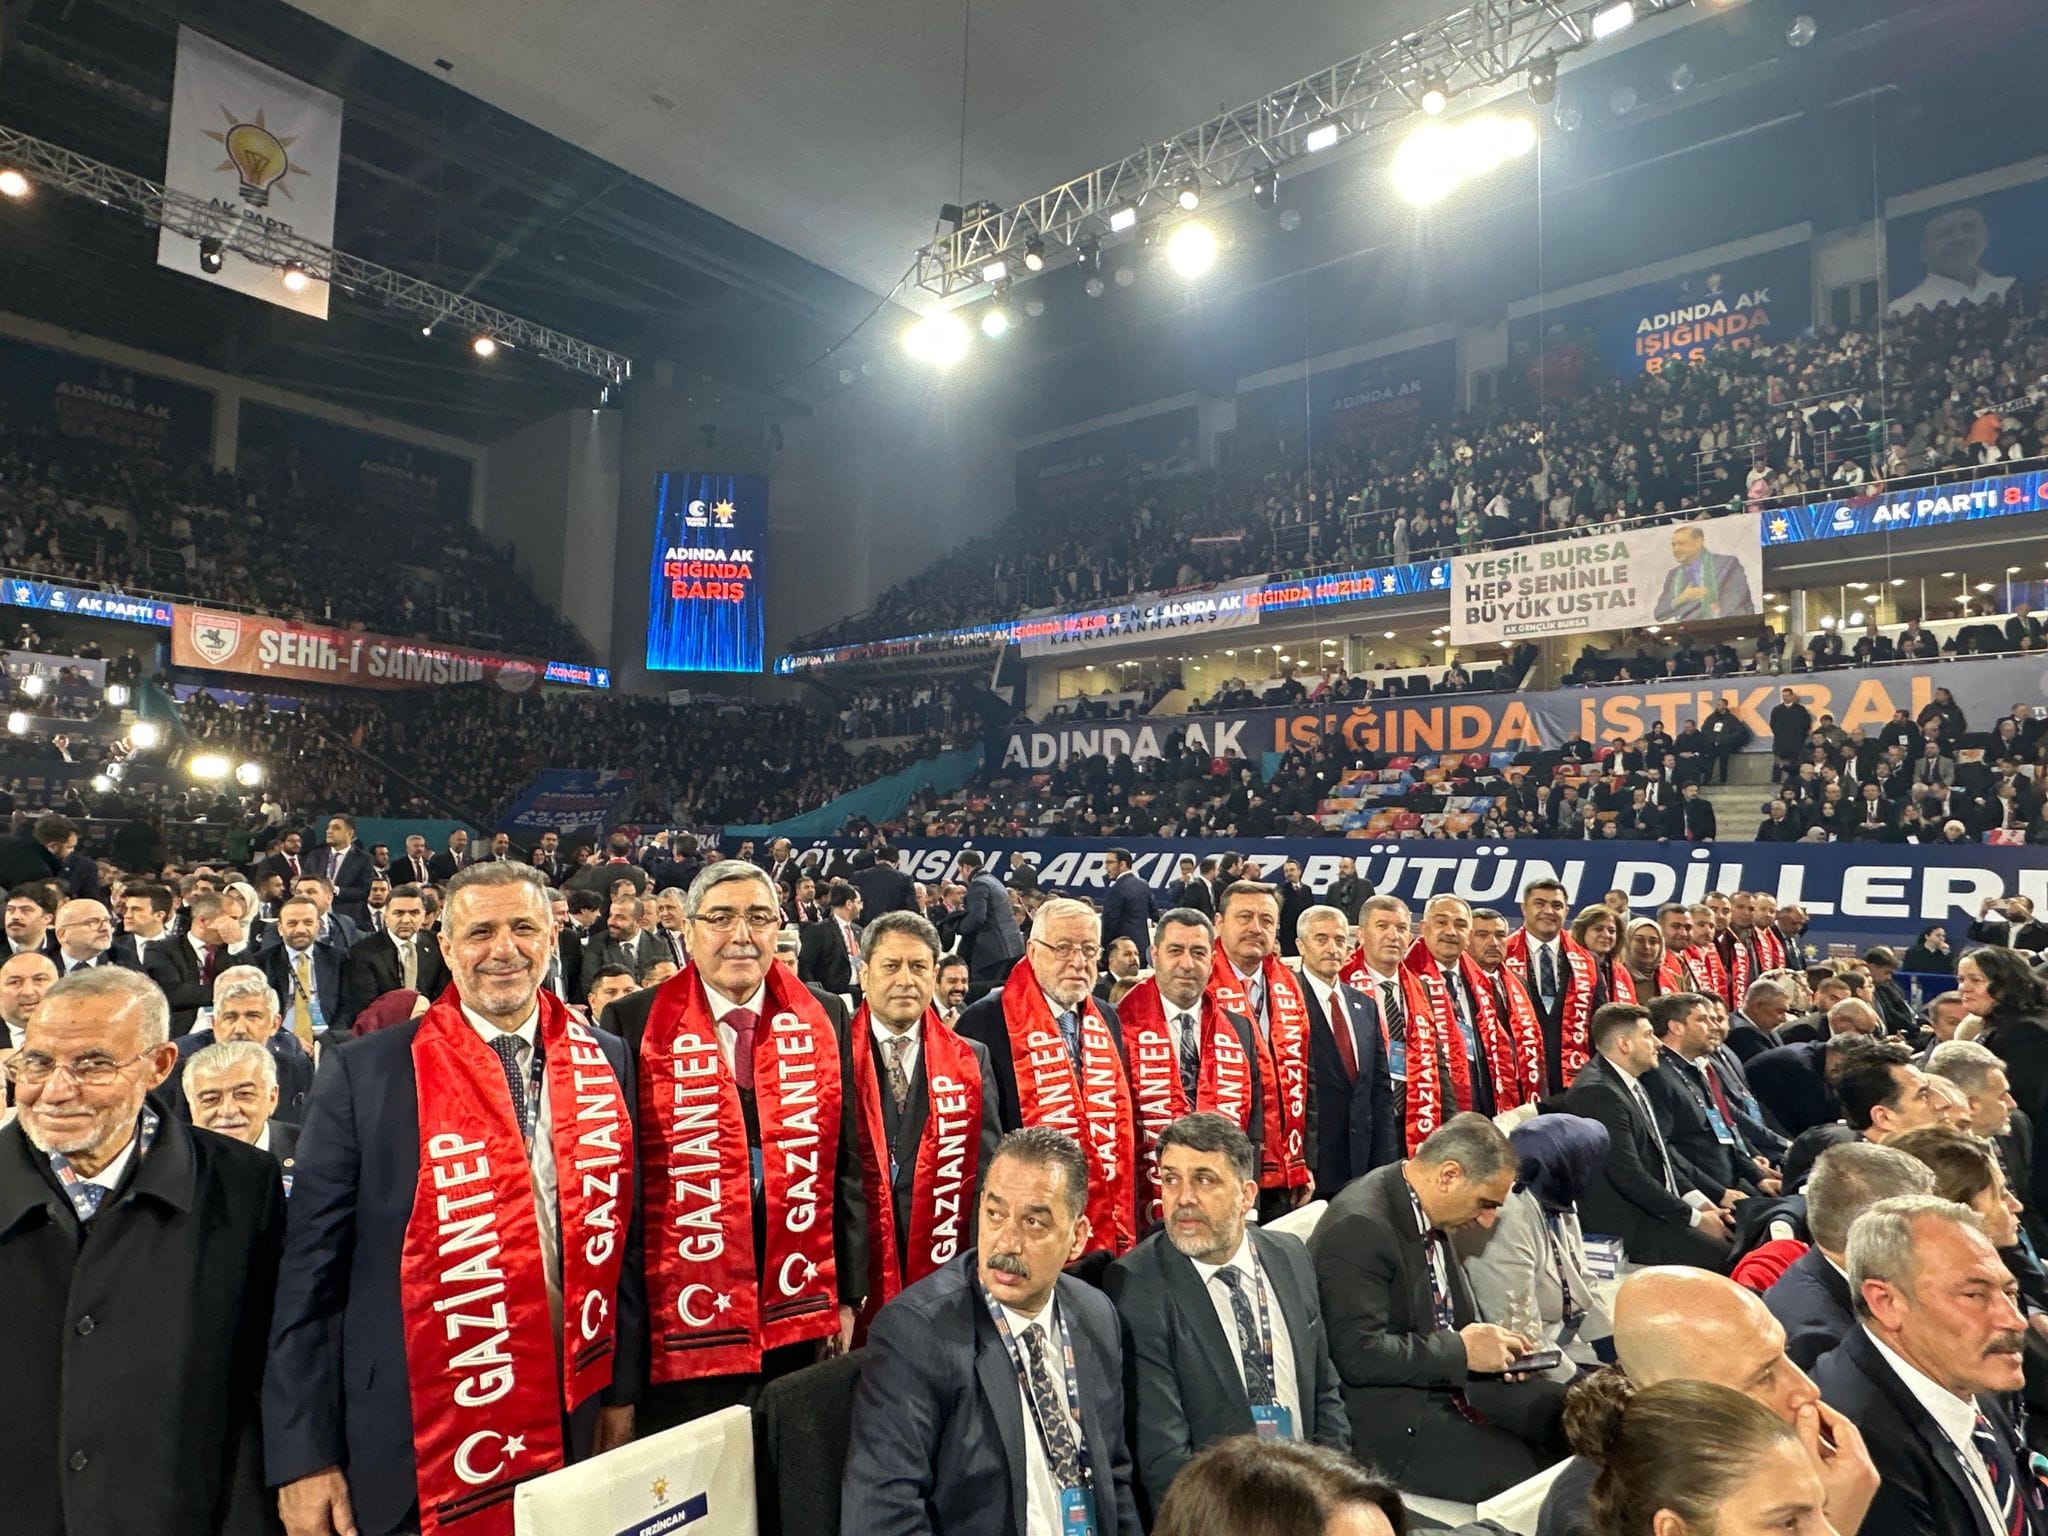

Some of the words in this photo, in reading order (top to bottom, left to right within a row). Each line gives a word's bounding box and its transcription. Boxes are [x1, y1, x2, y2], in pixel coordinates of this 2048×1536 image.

[1636, 299, 1728, 334] ADINDA
[1735, 287, 1771, 311] AK
[1636, 308, 1771, 357] IŞIĞINDA
[1872, 501, 1911, 523] AK
[2003, 487, 2029, 505] 8.
[663, 560, 753, 580] IŞIĞINDA
[665, 547, 727, 562] ADINDA
[729, 549, 754, 562] AK
[1465, 551, 1534, 580] YEŞİL
[1540, 541, 1630, 571] BURSA
[671, 580, 745, 604] BARIŞ
[1219, 595, 1242, 611] AK
[1316, 577, 1375, 598] HUZUR
[1465, 581, 1512, 602] HEP
[1518, 564, 1629, 598] SENİNLE
[77, 596, 102, 612] AK
[1465, 599, 1549, 625] BÜYÜK
[1557, 587, 1636, 614] USTA!
[1050, 610, 1218, 646] KAHRAMANMARAŞ
[1505, 624, 1518, 634] AK
[1557, 618, 1588, 629] BURSA
[368, 644, 484, 685] SAMSUN
[1001, 726, 1156, 770] ADINDA
[1303, 844, 1585, 905] BÜTÜN
[771, 1012, 820, 1234] GAZİANTEP
[667, 1032, 726, 1263] GAZİANTEP
[428, 1132, 516, 1408] GAZİANTEP
